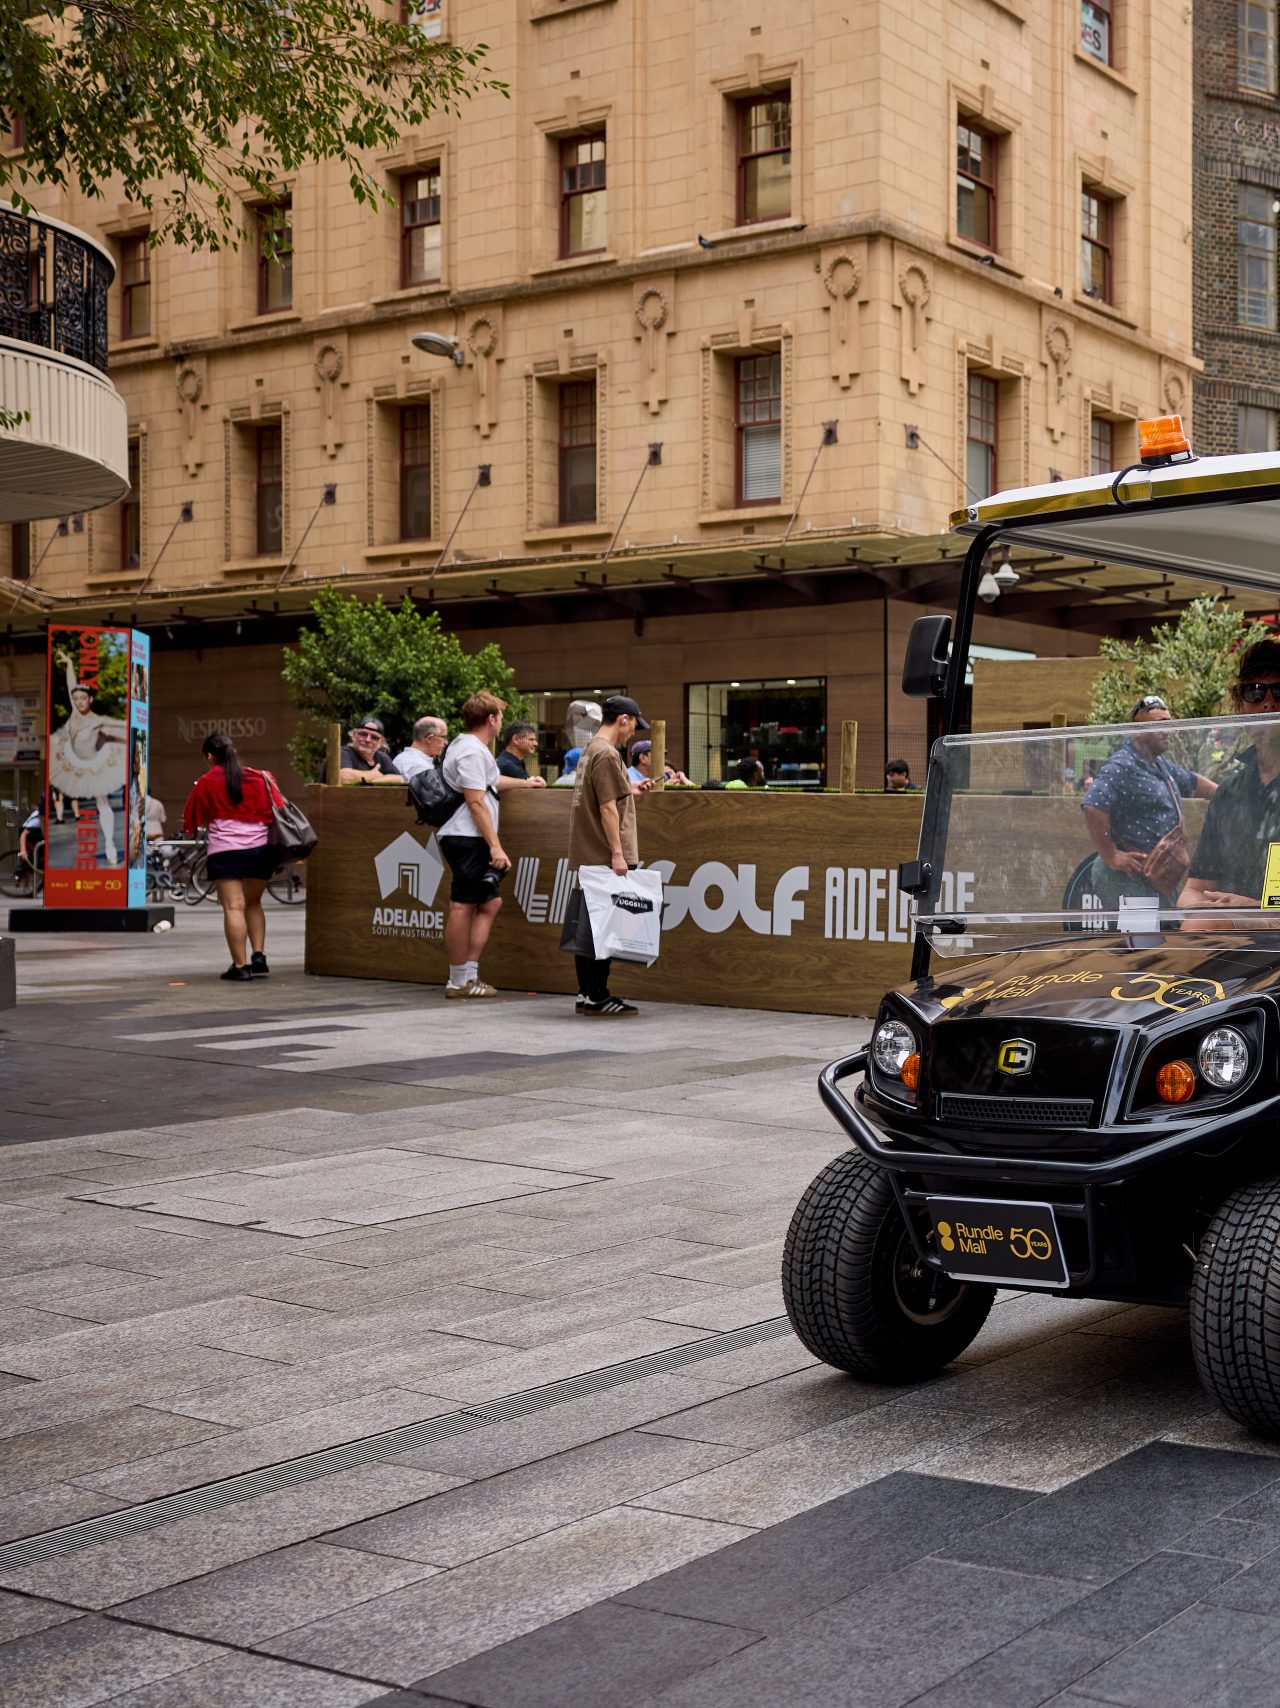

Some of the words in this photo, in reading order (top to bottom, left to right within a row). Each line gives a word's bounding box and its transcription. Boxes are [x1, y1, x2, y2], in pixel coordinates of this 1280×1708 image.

[79, 629, 99, 690] ONLY
[177, 716, 266, 742] NESPRESSO
[76, 809, 97, 872] HERE
[372, 907, 444, 930] ADELAIDE
[372, 926, 398, 936] SOUTH
[400, 928, 443, 940] AUSTRALIA
[975, 984, 1044, 1002] Mall
[998, 970, 1104, 988] Rundle
[1110, 972, 1225, 1013] 50
[1169, 987, 1210, 1003] YEARS
[955, 1222, 1004, 1241] Rundle
[1009, 1227, 1053, 1260] 50
[959, 1238, 987, 1255] Mall
